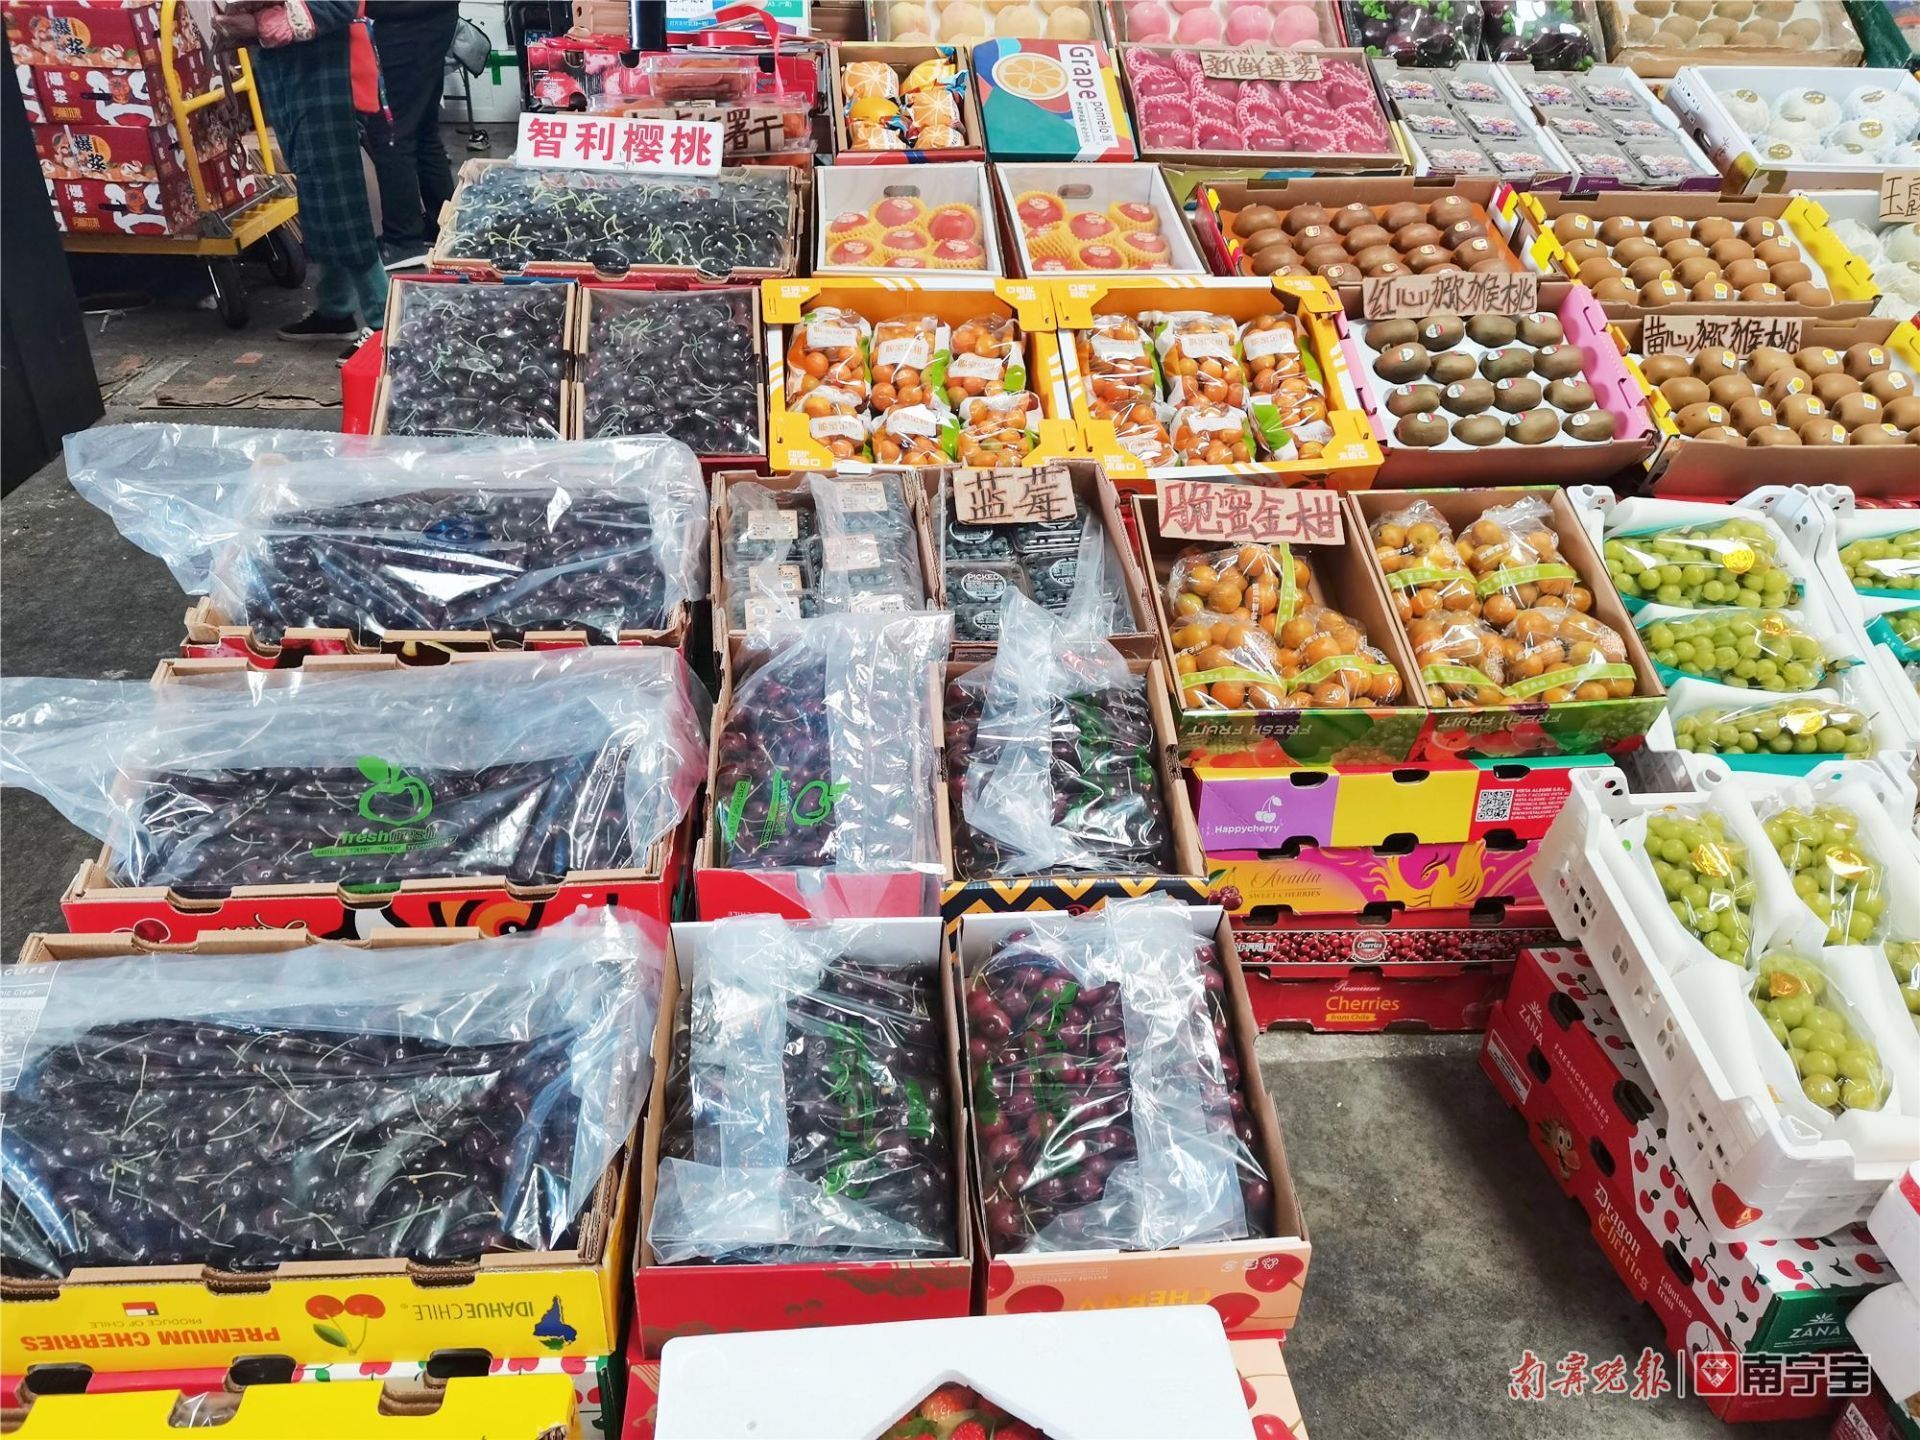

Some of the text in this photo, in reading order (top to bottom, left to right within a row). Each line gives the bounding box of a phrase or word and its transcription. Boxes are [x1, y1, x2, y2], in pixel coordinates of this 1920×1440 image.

[1069, 46, 1098, 99] Grape
[1090, 101, 1110, 134] pomelo
[527, 117, 714, 166] 智利樱桃
[1367, 273, 1537, 319] 红心猕猴桃
[962, 465, 1075, 521] 蓝莓
[1159, 482, 1342, 541] 脆蜜金柑
[967, 573, 1000, 581] PICKED
[1186, 724, 1313, 738] FRESH FRUIT
[1437, 713, 1563, 729] FRESH FRUIT
[1215, 824, 1281, 833] Happycherry
[1250, 867, 1322, 888] Arcadia
[1278, 890, 1322, 898] CHERRIES
[1356, 941, 1383, 949] Cherries
[1329, 979, 1382, 993] Premium
[1325, 995, 1400, 1011] Cherries
[1518, 1004, 1544, 1047] ZANA
[1554, 1042, 1611, 1124] FRESHCHERRIES
[1593, 1182, 1642, 1258] Dragon
[1597, 1213, 1650, 1293] Cherries
[412, 1301, 536, 1323] IDAHUECHILE
[88, 1318, 203, 1329] PRODUCE OF CHILE
[1789, 1325, 1841, 1339] ZANA
[21, 1326, 281, 1352] PREMIUM CHERRIES
